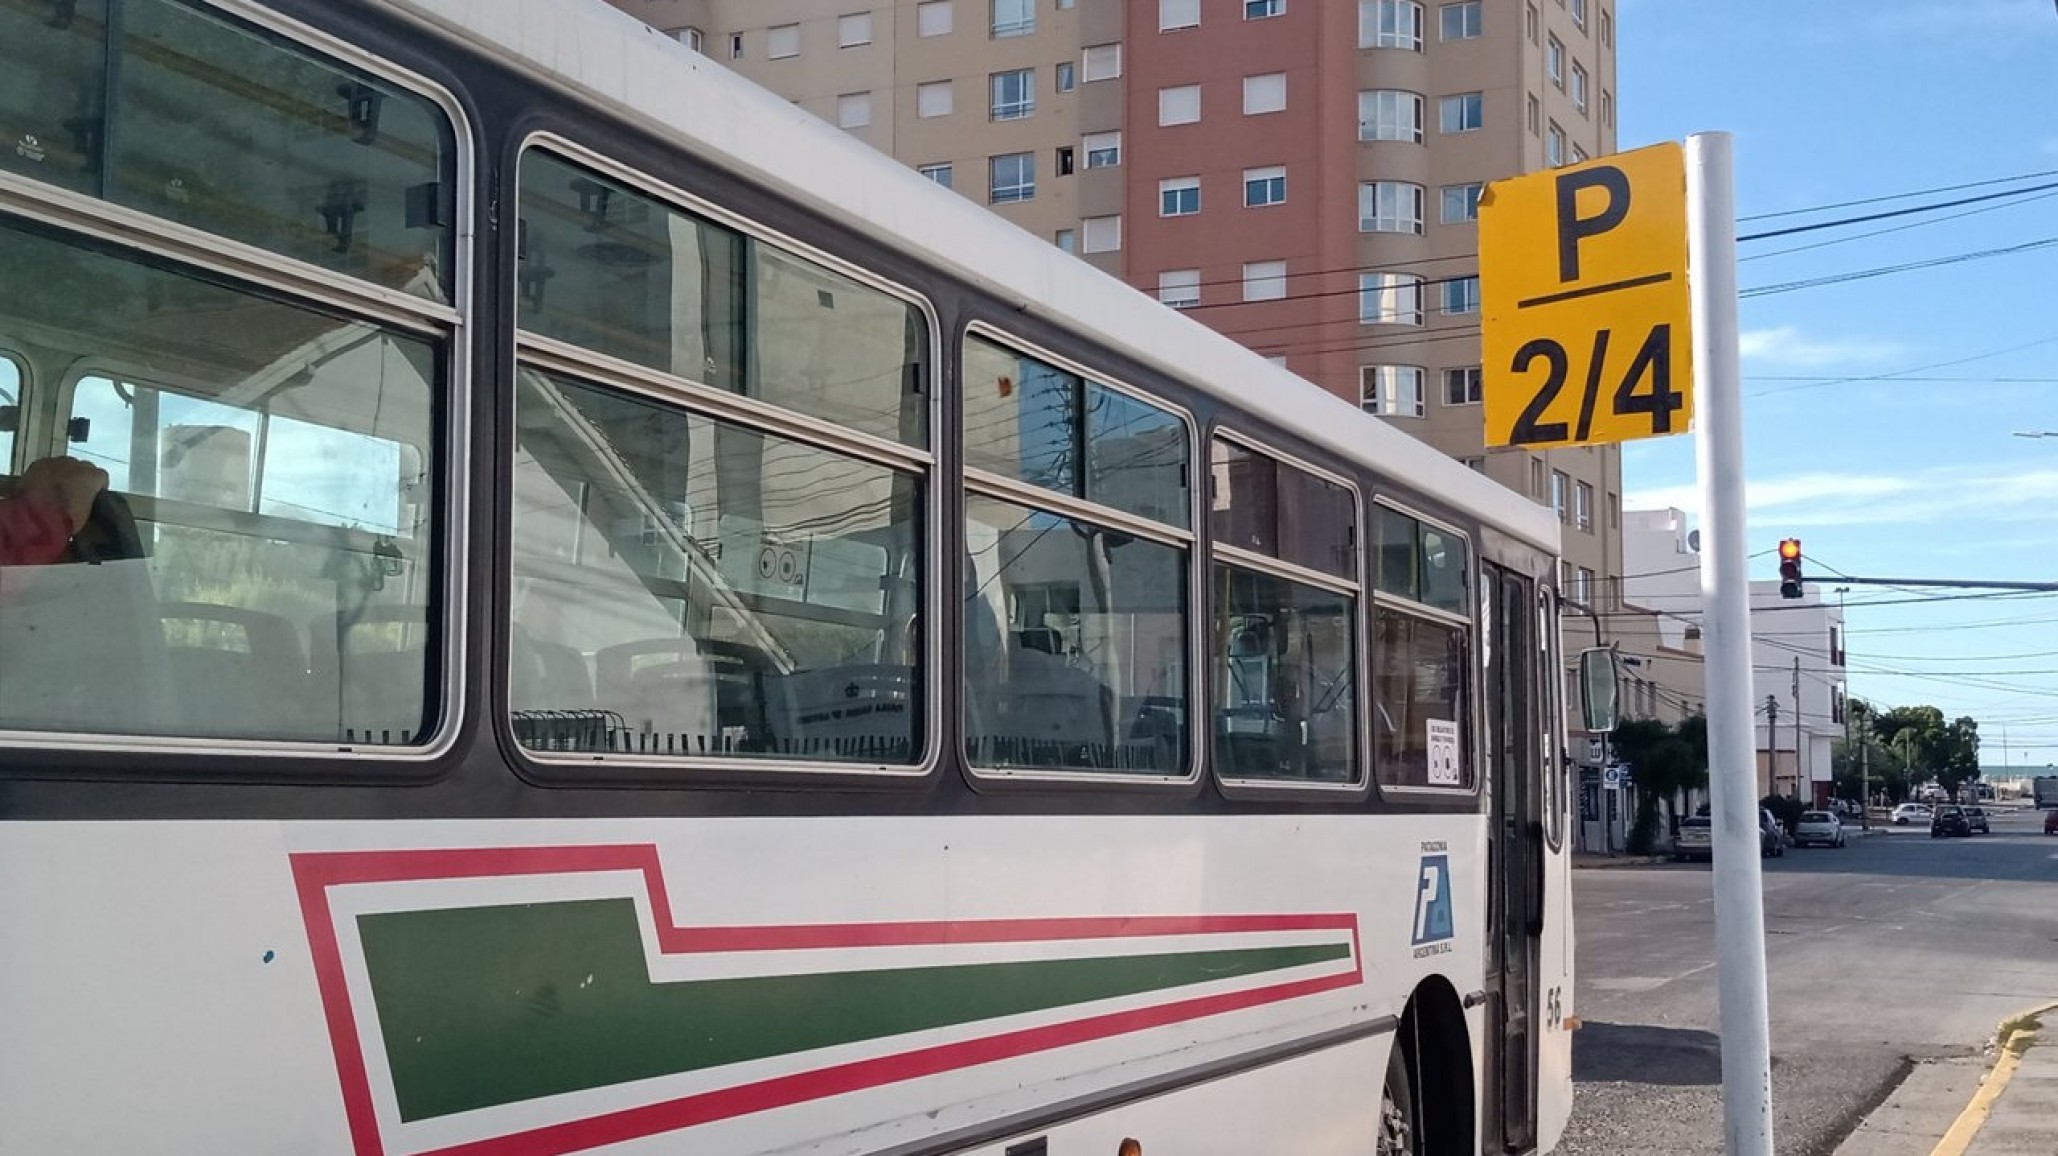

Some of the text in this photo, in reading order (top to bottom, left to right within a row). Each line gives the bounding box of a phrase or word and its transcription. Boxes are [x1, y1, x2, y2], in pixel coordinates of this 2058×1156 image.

[1556, 165, 1631, 283] P
[1509, 323, 1683, 446] 2/4
[1547, 986, 1561, 1028] 56
